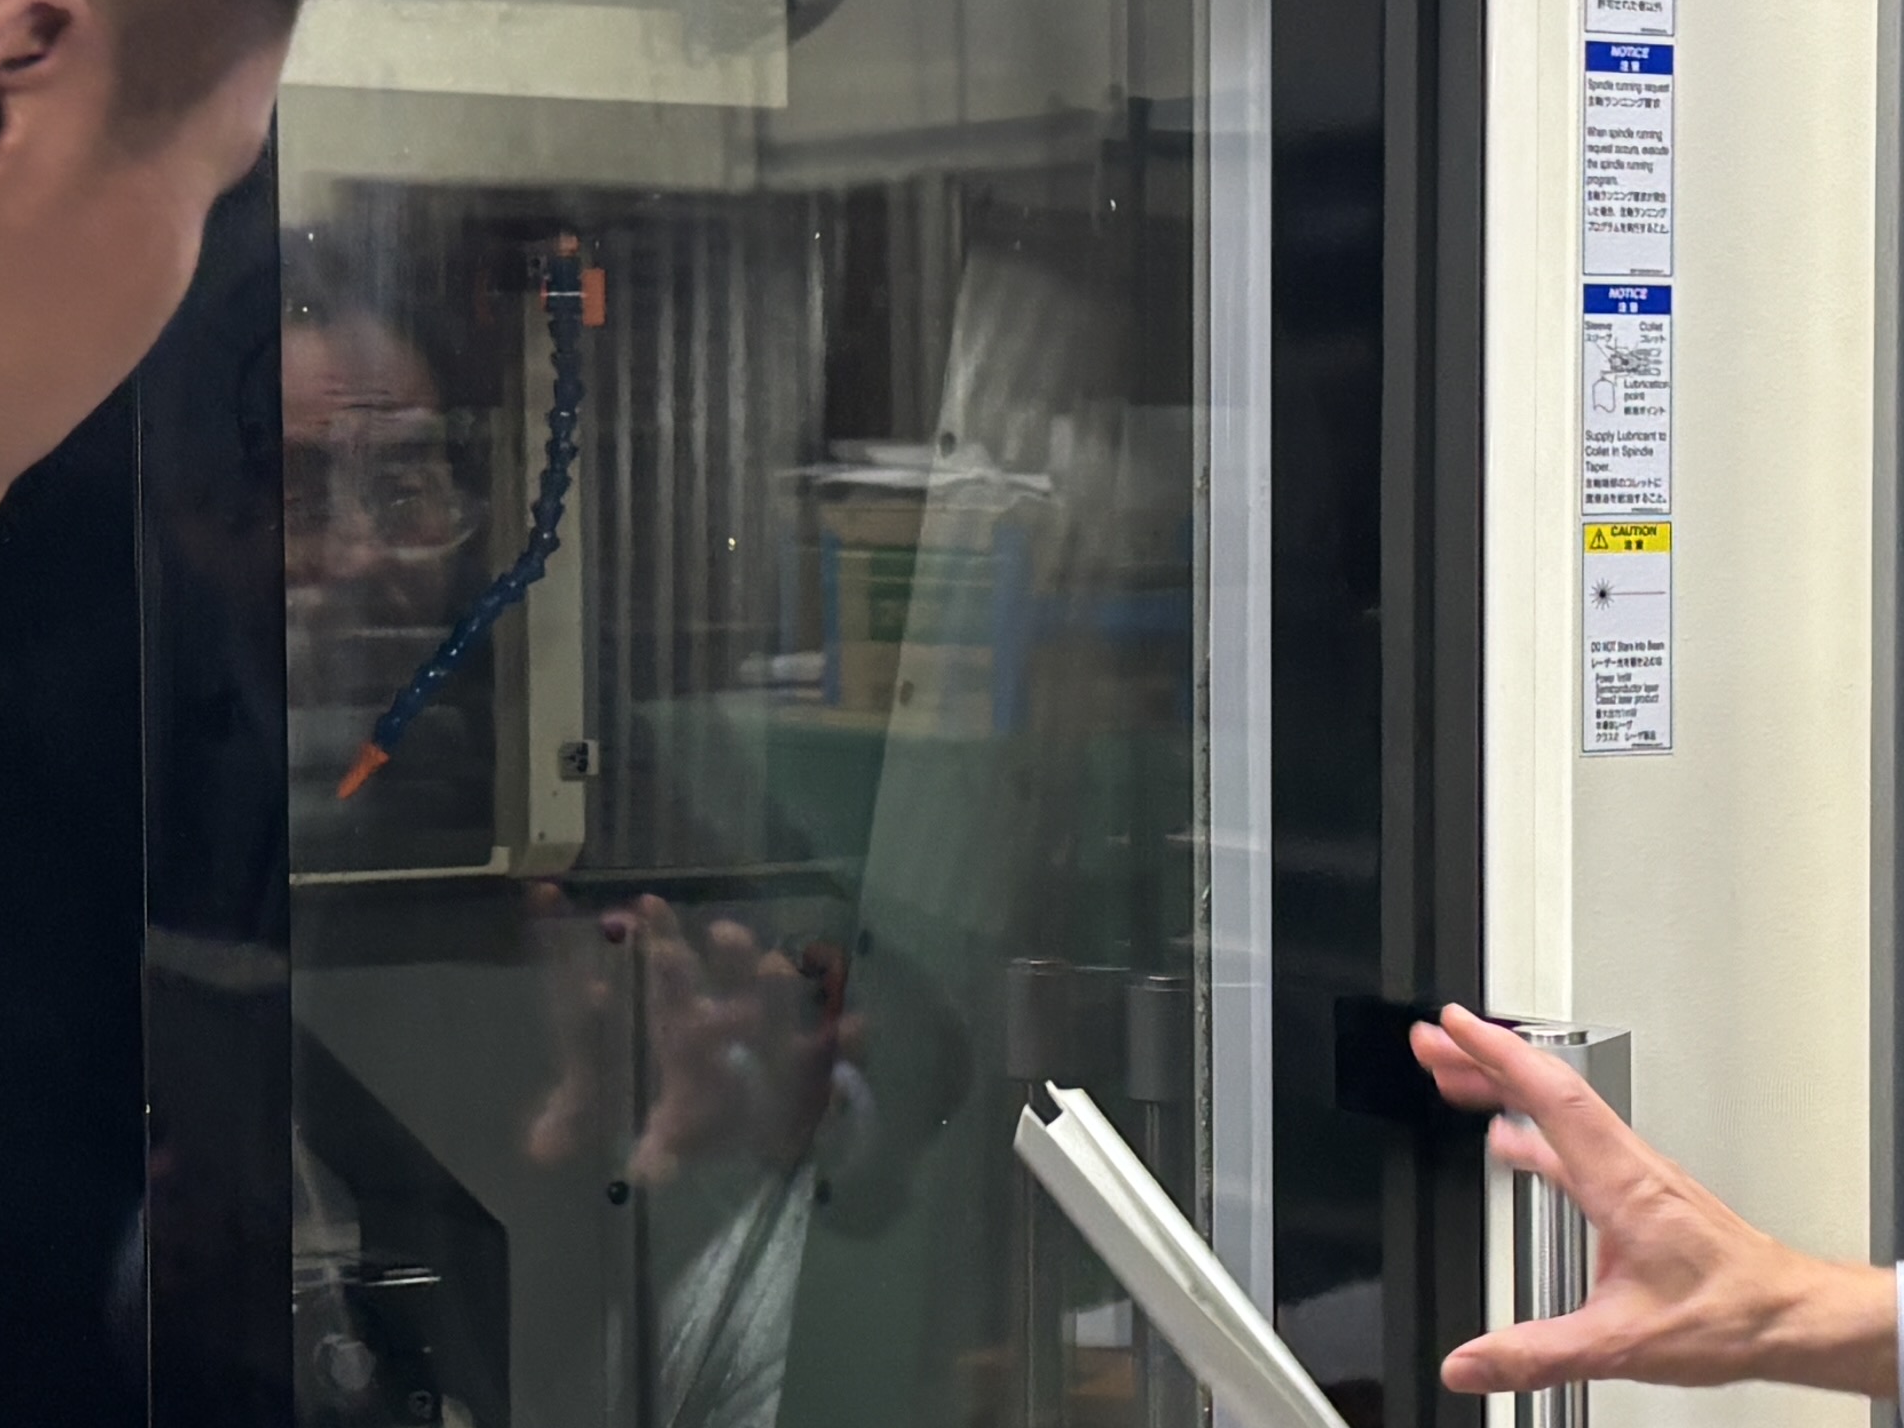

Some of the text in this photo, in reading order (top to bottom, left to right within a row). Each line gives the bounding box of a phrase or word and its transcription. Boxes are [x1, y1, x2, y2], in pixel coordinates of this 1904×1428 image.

[1610, 45, 1650, 58] NOTICE
[1609, 287, 1648, 298] NOTICE
[1610, 526, 1657, 535] CAUTION
